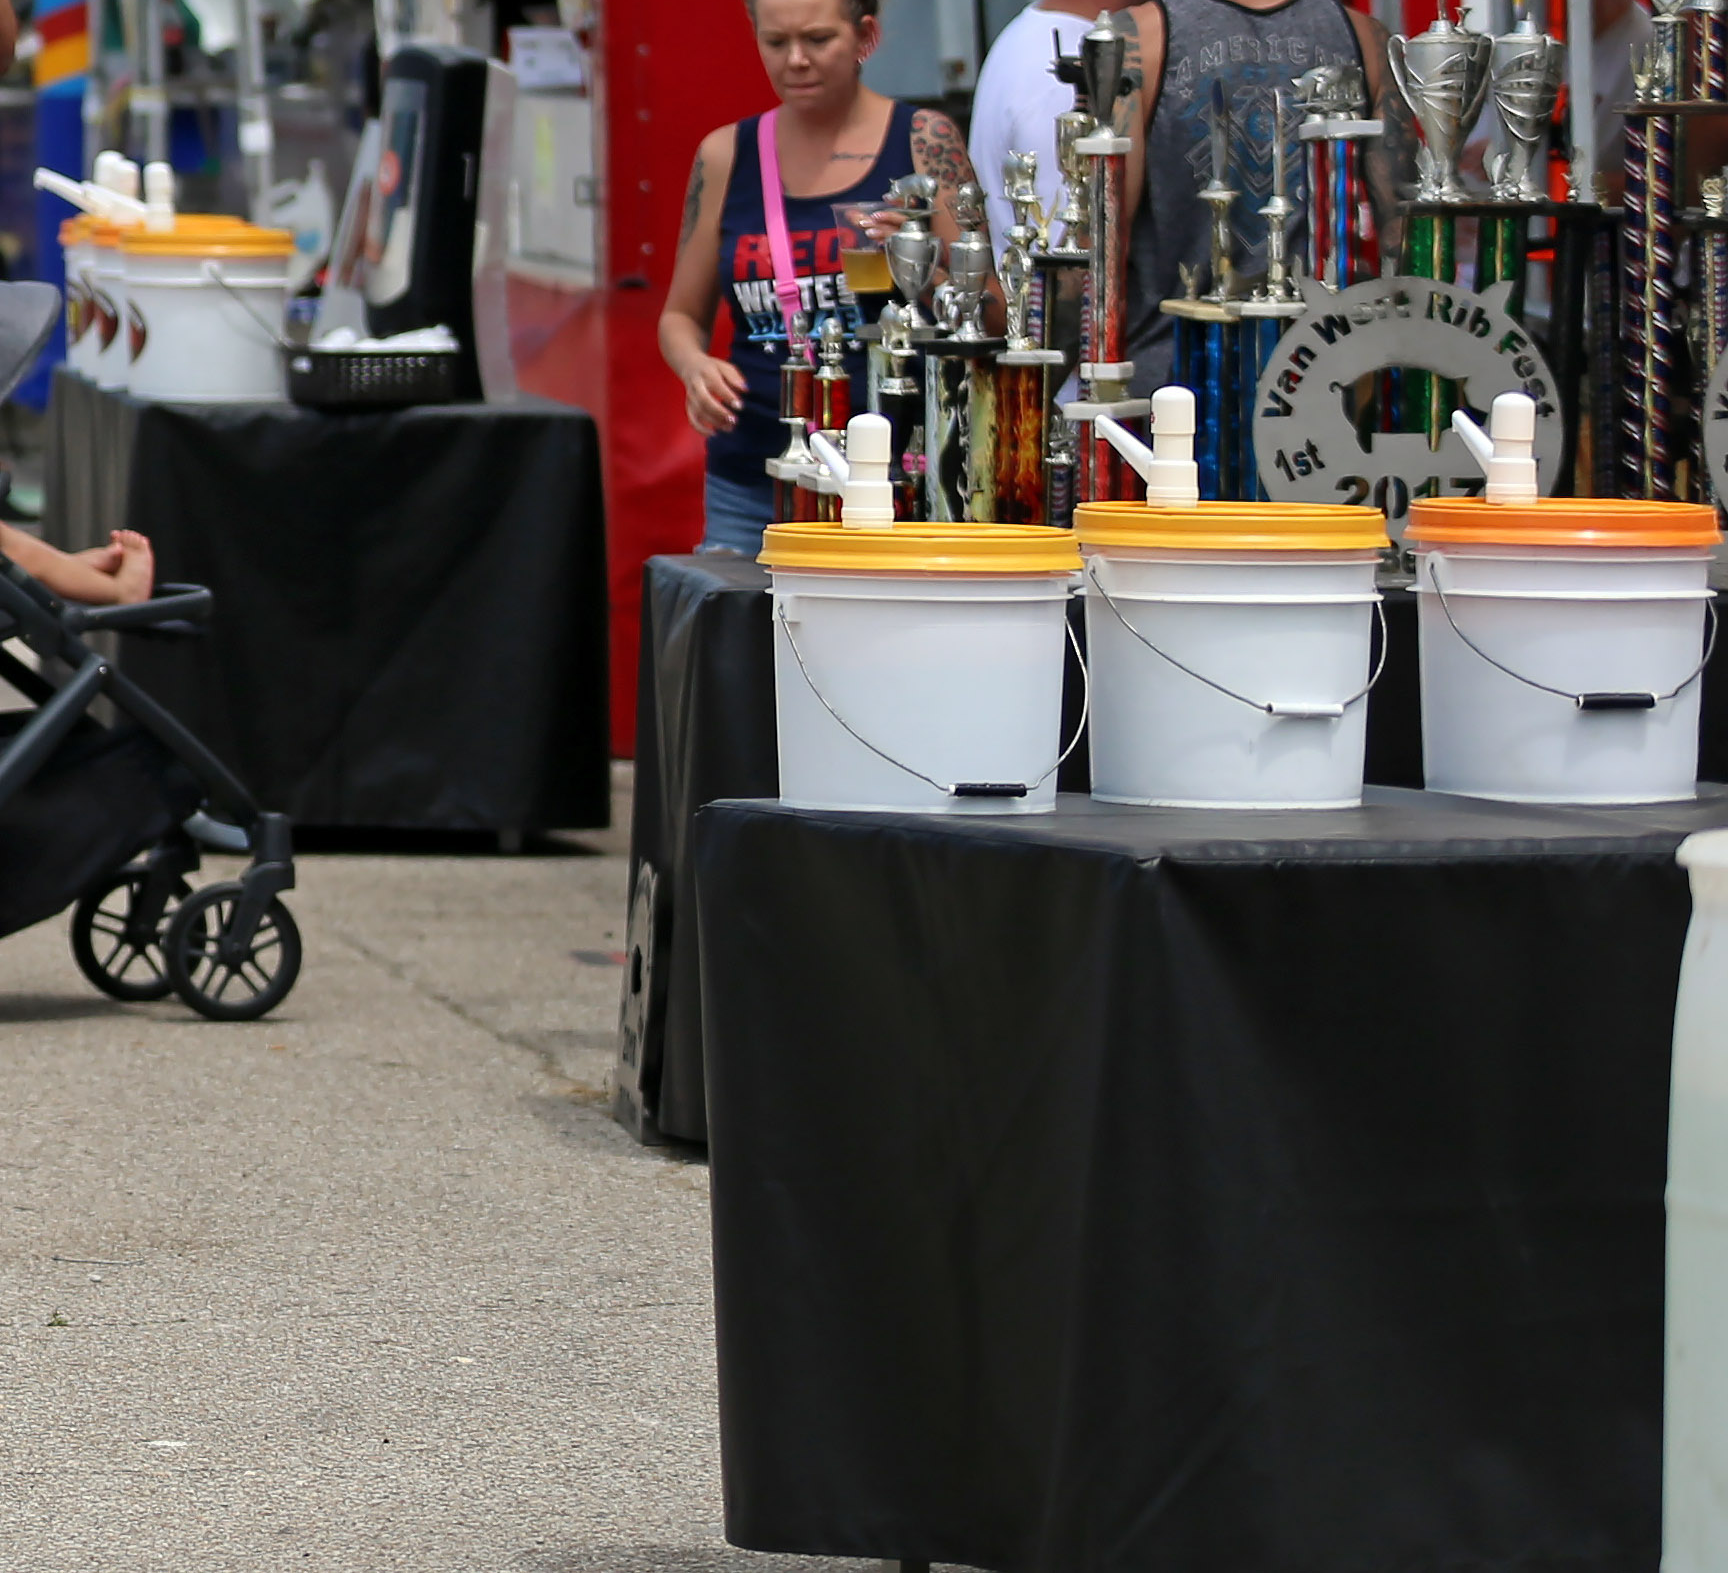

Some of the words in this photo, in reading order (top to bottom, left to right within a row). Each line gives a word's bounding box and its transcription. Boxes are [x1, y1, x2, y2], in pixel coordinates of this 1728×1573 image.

[733, 227, 859, 280] RED
[732, 275, 836, 313] WHTE
[1261, 343, 1318, 418] Van
[1425, 290, 1491, 338] Rib
[1273, 438, 1326, 483] 1st
